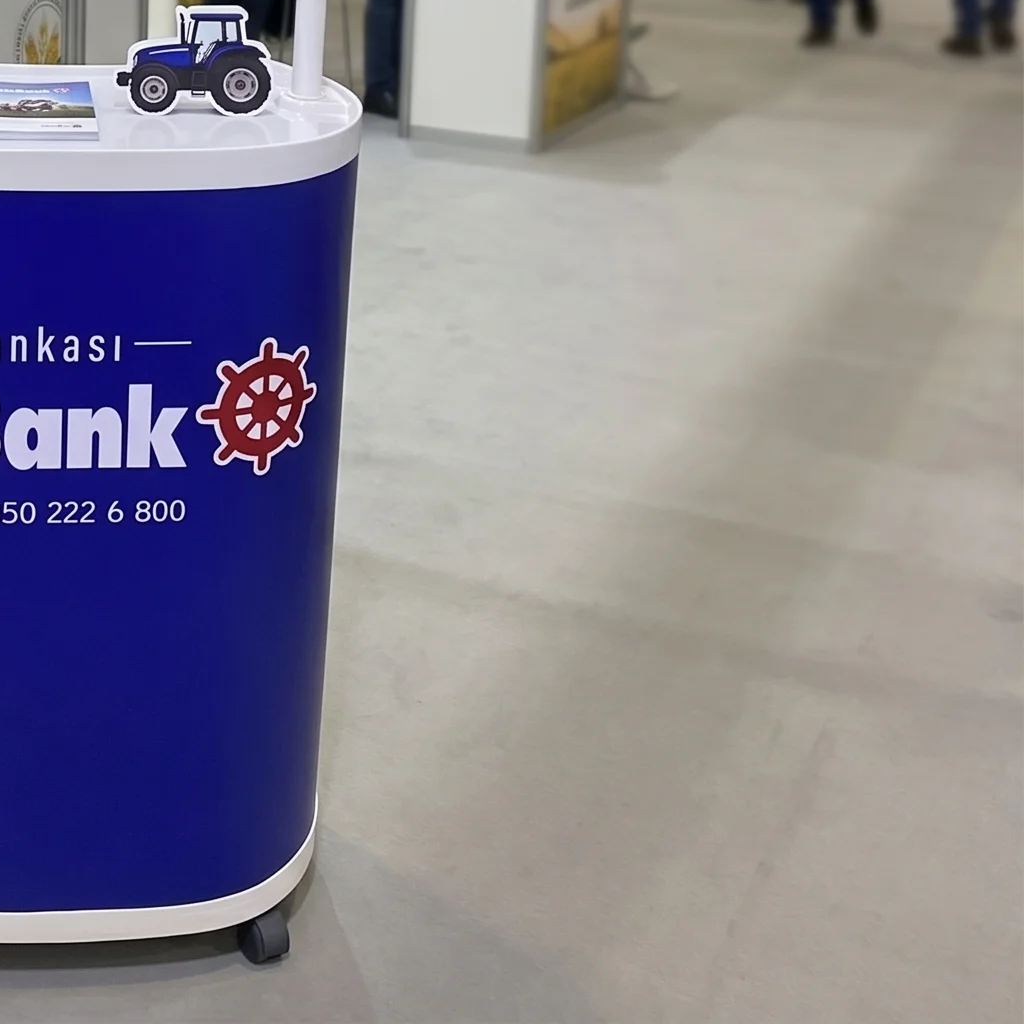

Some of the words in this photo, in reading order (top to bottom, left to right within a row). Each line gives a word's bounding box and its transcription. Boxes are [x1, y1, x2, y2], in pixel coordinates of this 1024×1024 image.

[46, 500, 96, 524] 222
[107, 500, 124, 523] 6
[134, 499, 186, 523] 800
